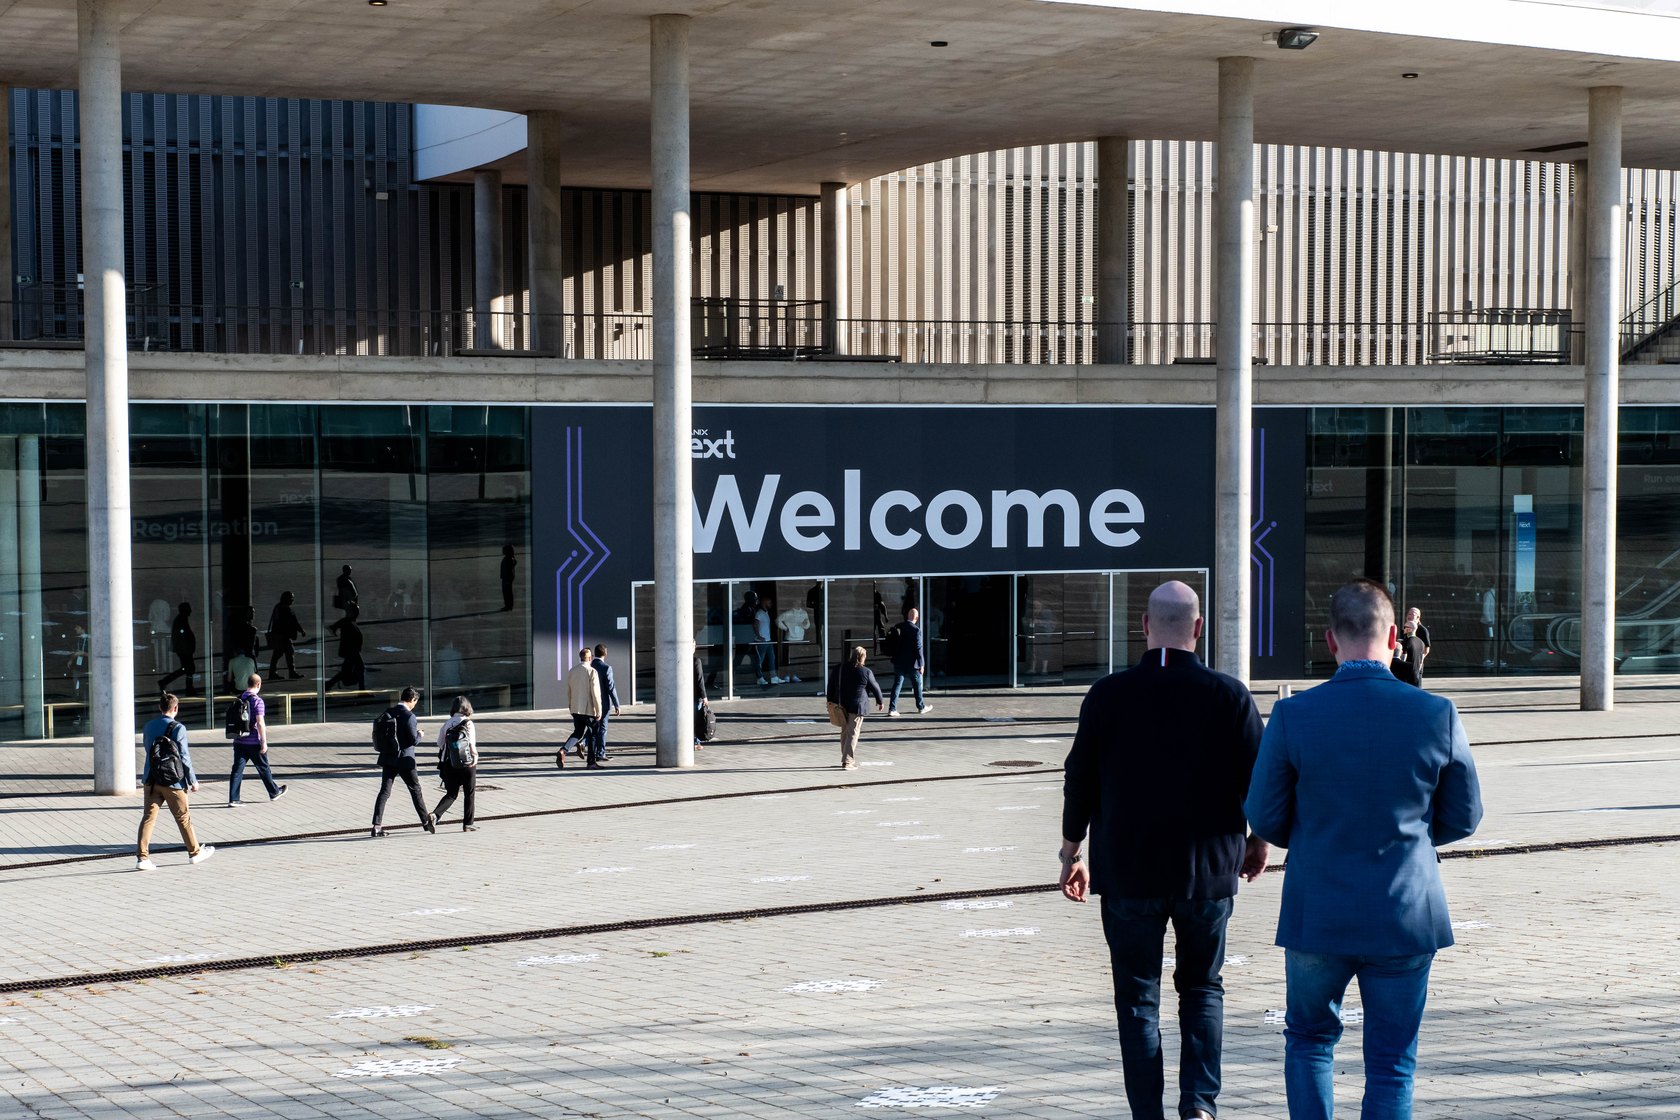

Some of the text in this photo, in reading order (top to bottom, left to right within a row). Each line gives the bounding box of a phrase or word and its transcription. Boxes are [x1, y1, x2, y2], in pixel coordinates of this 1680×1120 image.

[691, 430, 736, 459] ext
[692, 470, 1145, 553] Welcome
[133, 518, 278, 541] Registration
